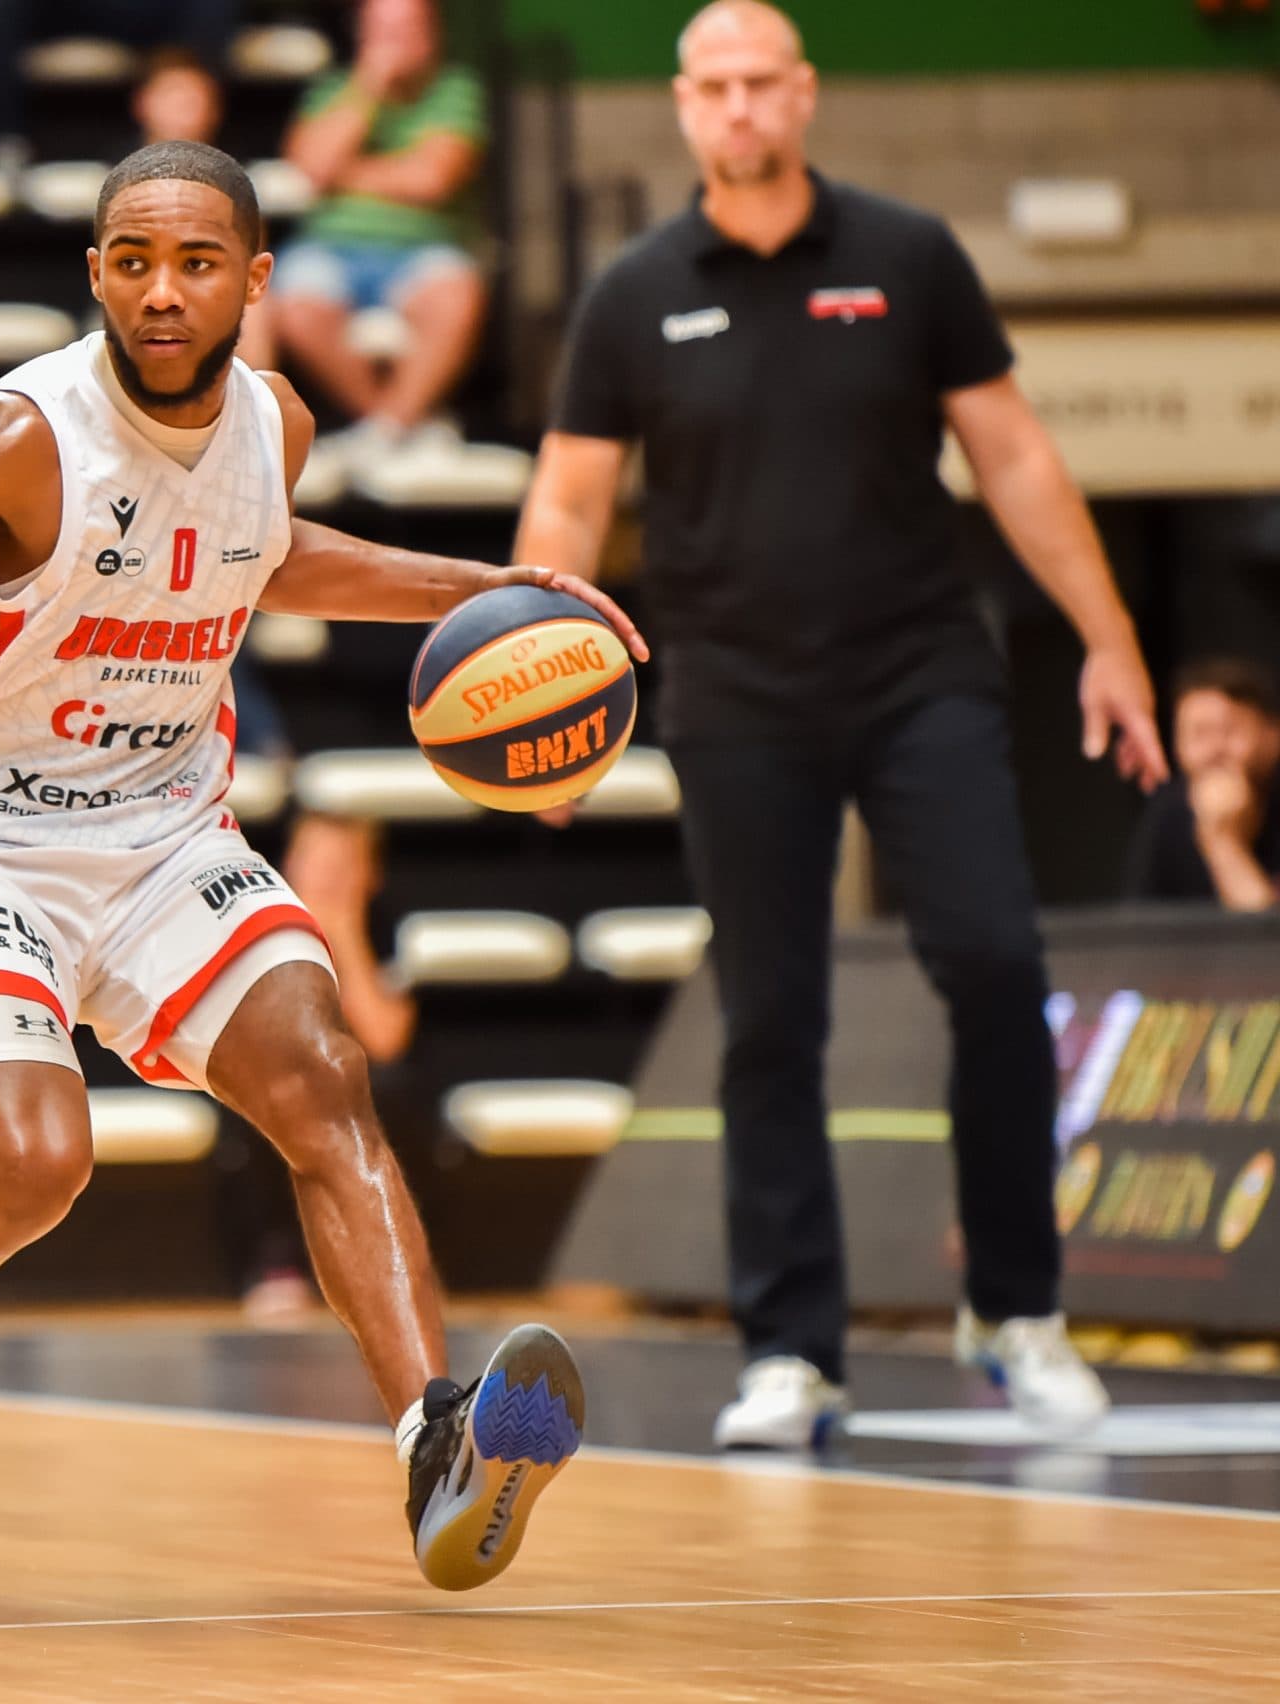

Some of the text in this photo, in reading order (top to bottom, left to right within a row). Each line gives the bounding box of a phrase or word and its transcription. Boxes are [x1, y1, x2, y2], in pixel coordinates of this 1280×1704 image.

[170, 528, 197, 591] 0
[100, 667, 201, 685] BASKETBALL
[462, 637, 606, 724] SPALDING
[51, 699, 196, 750] Circu
[507, 706, 607, 779] BNXT
